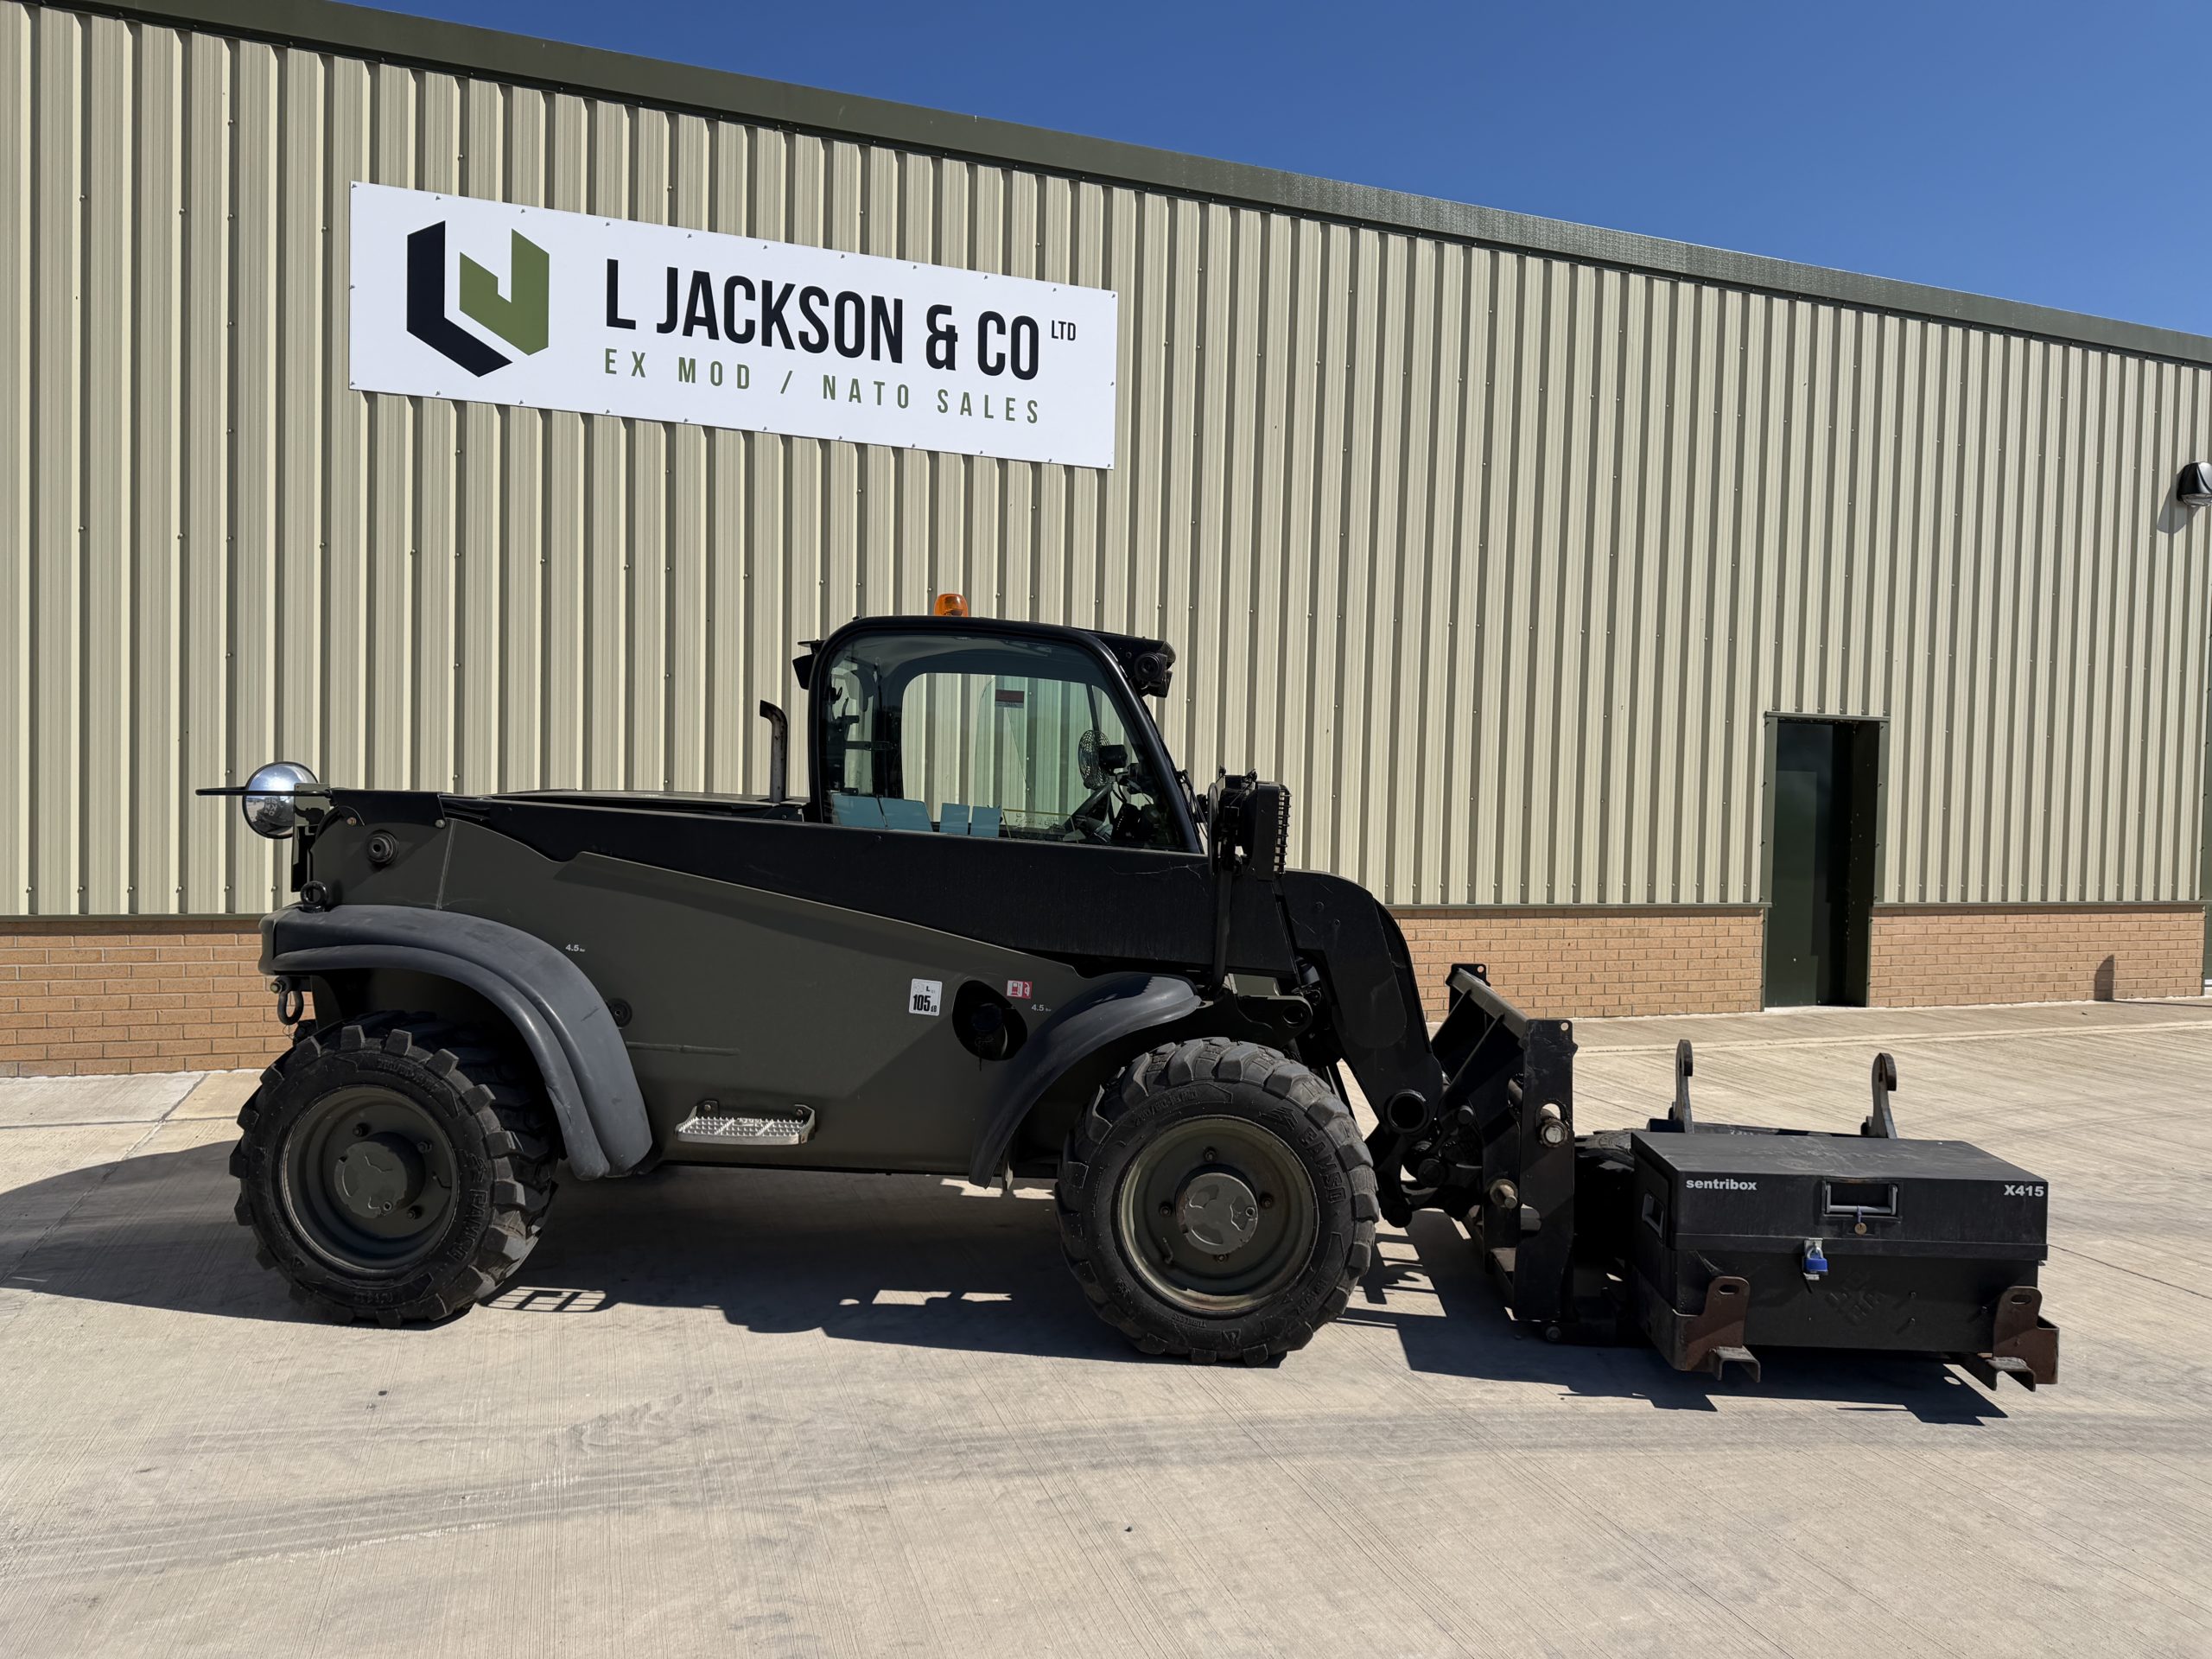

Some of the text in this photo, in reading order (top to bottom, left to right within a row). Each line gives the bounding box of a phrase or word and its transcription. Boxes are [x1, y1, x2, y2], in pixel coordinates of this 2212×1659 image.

[607, 258, 1077, 380] L JACKSON & CO LTD
[605, 347, 1039, 424] EX MOD / NATO SALES
[565, 944, 580, 952] 4.5
[912, 994, 931, 1012] 105
[1031, 1003, 1045, 1012] 4.5
[1686, 1178, 1758, 1191] sentribox
[2003, 1184, 2044, 1198] X415
